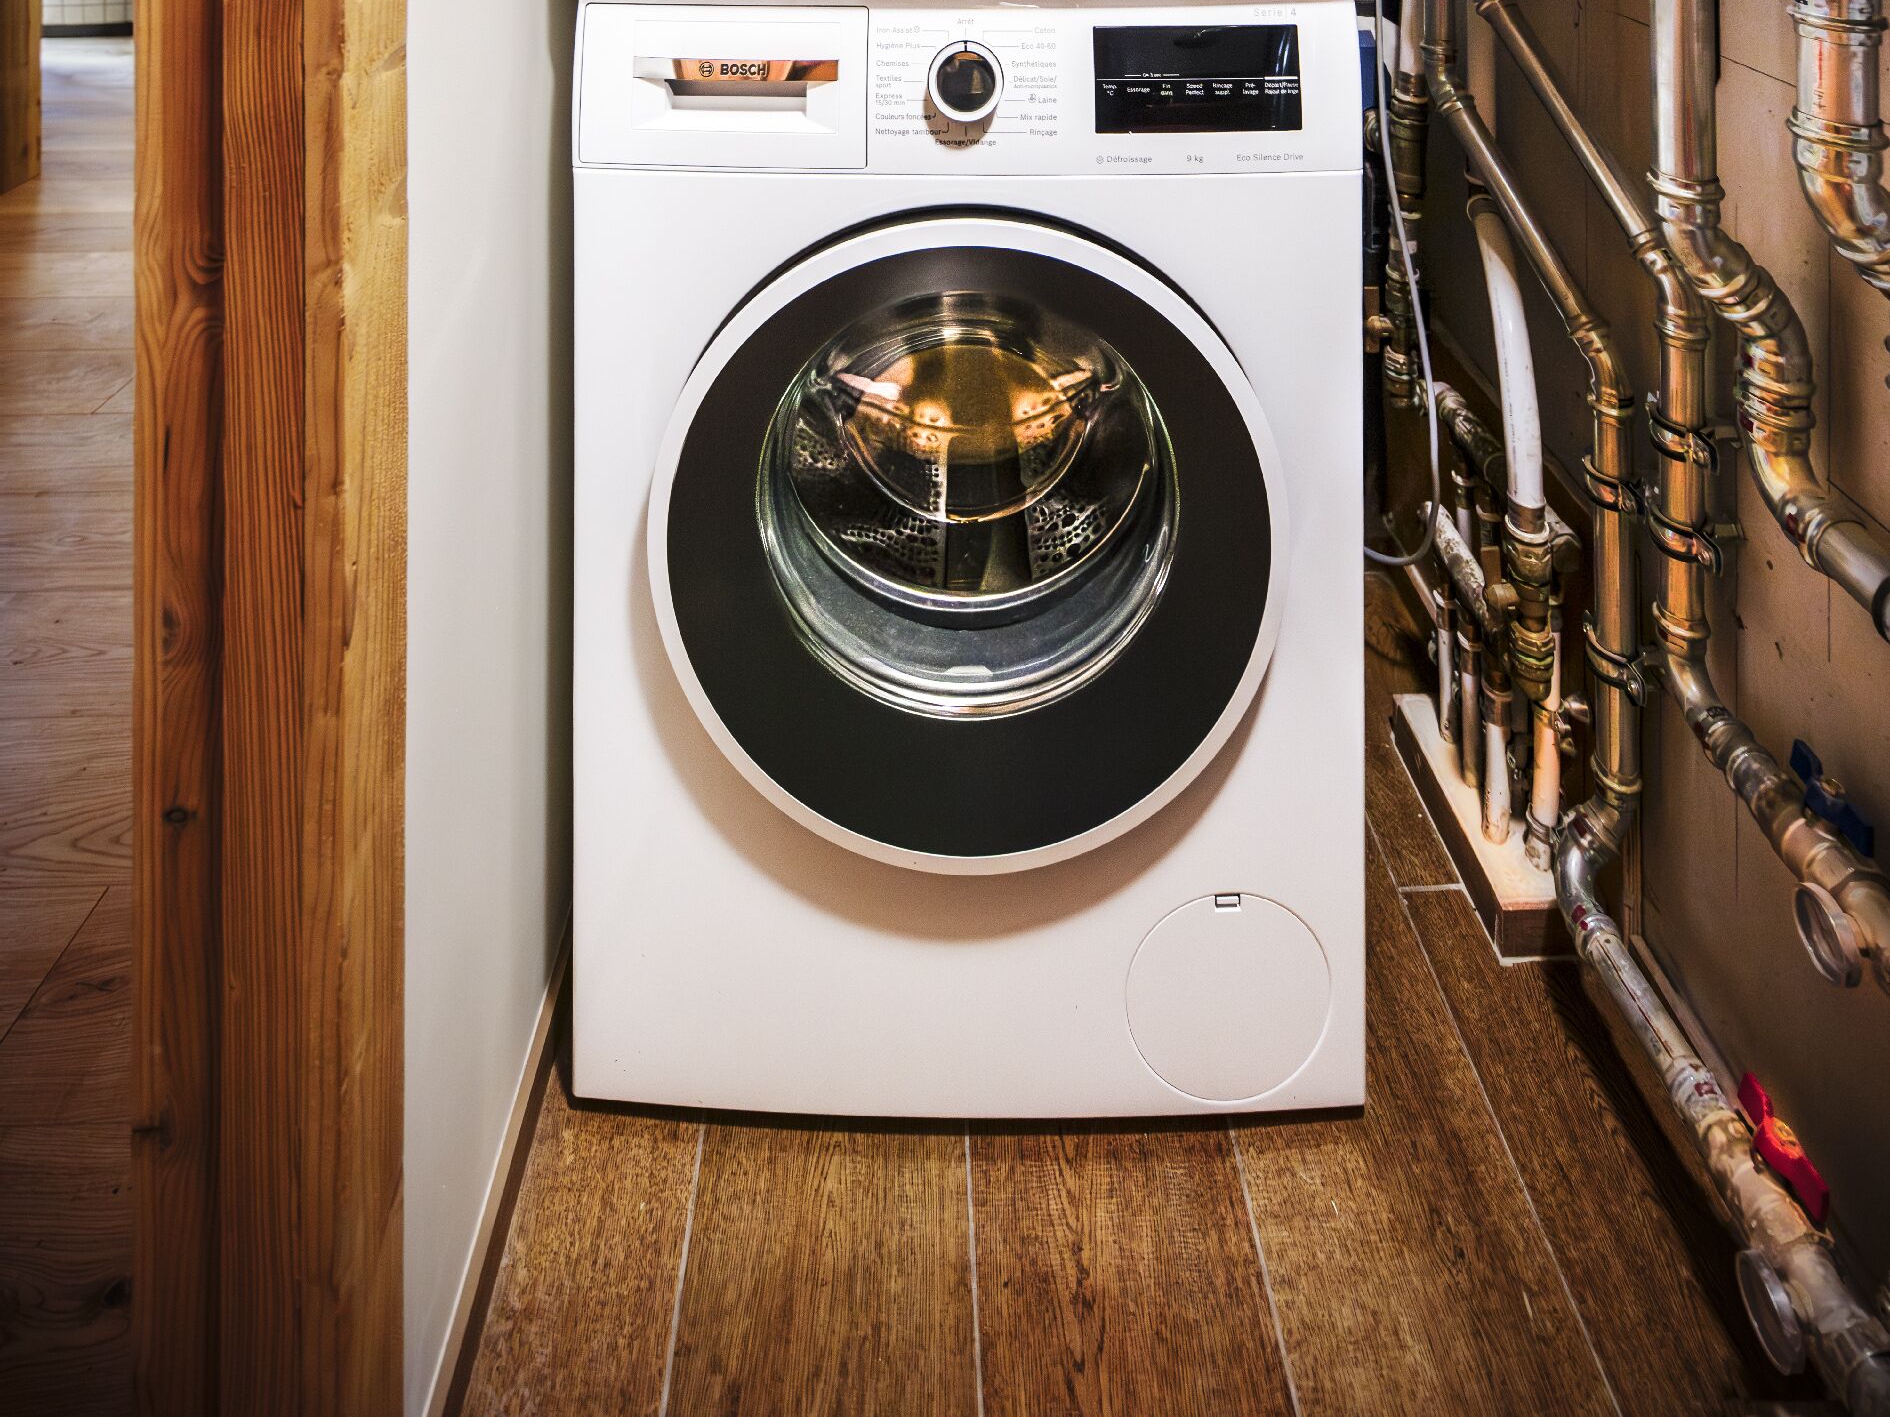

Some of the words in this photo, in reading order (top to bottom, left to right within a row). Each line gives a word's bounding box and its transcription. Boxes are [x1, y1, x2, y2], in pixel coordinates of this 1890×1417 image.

[876, 42, 904, 50] Hygiène
[1011, 60, 1057, 68] Synthétiques
[720, 63, 768, 76] BOSCH
[1034, 114, 1058, 122] rapide
[875, 128, 910, 137] Nettoyage
[1029, 129, 1058, 137] Rinçage
[934, 138, 997, 147] Essorage/Vidange
[1106, 155, 1153, 164] Défroissage
[1194, 155, 1204, 163] kg
[1236, 154, 1251, 162] Eco
[1253, 153, 1282, 161] Silence
[1283, 153, 1304, 161] Drive
